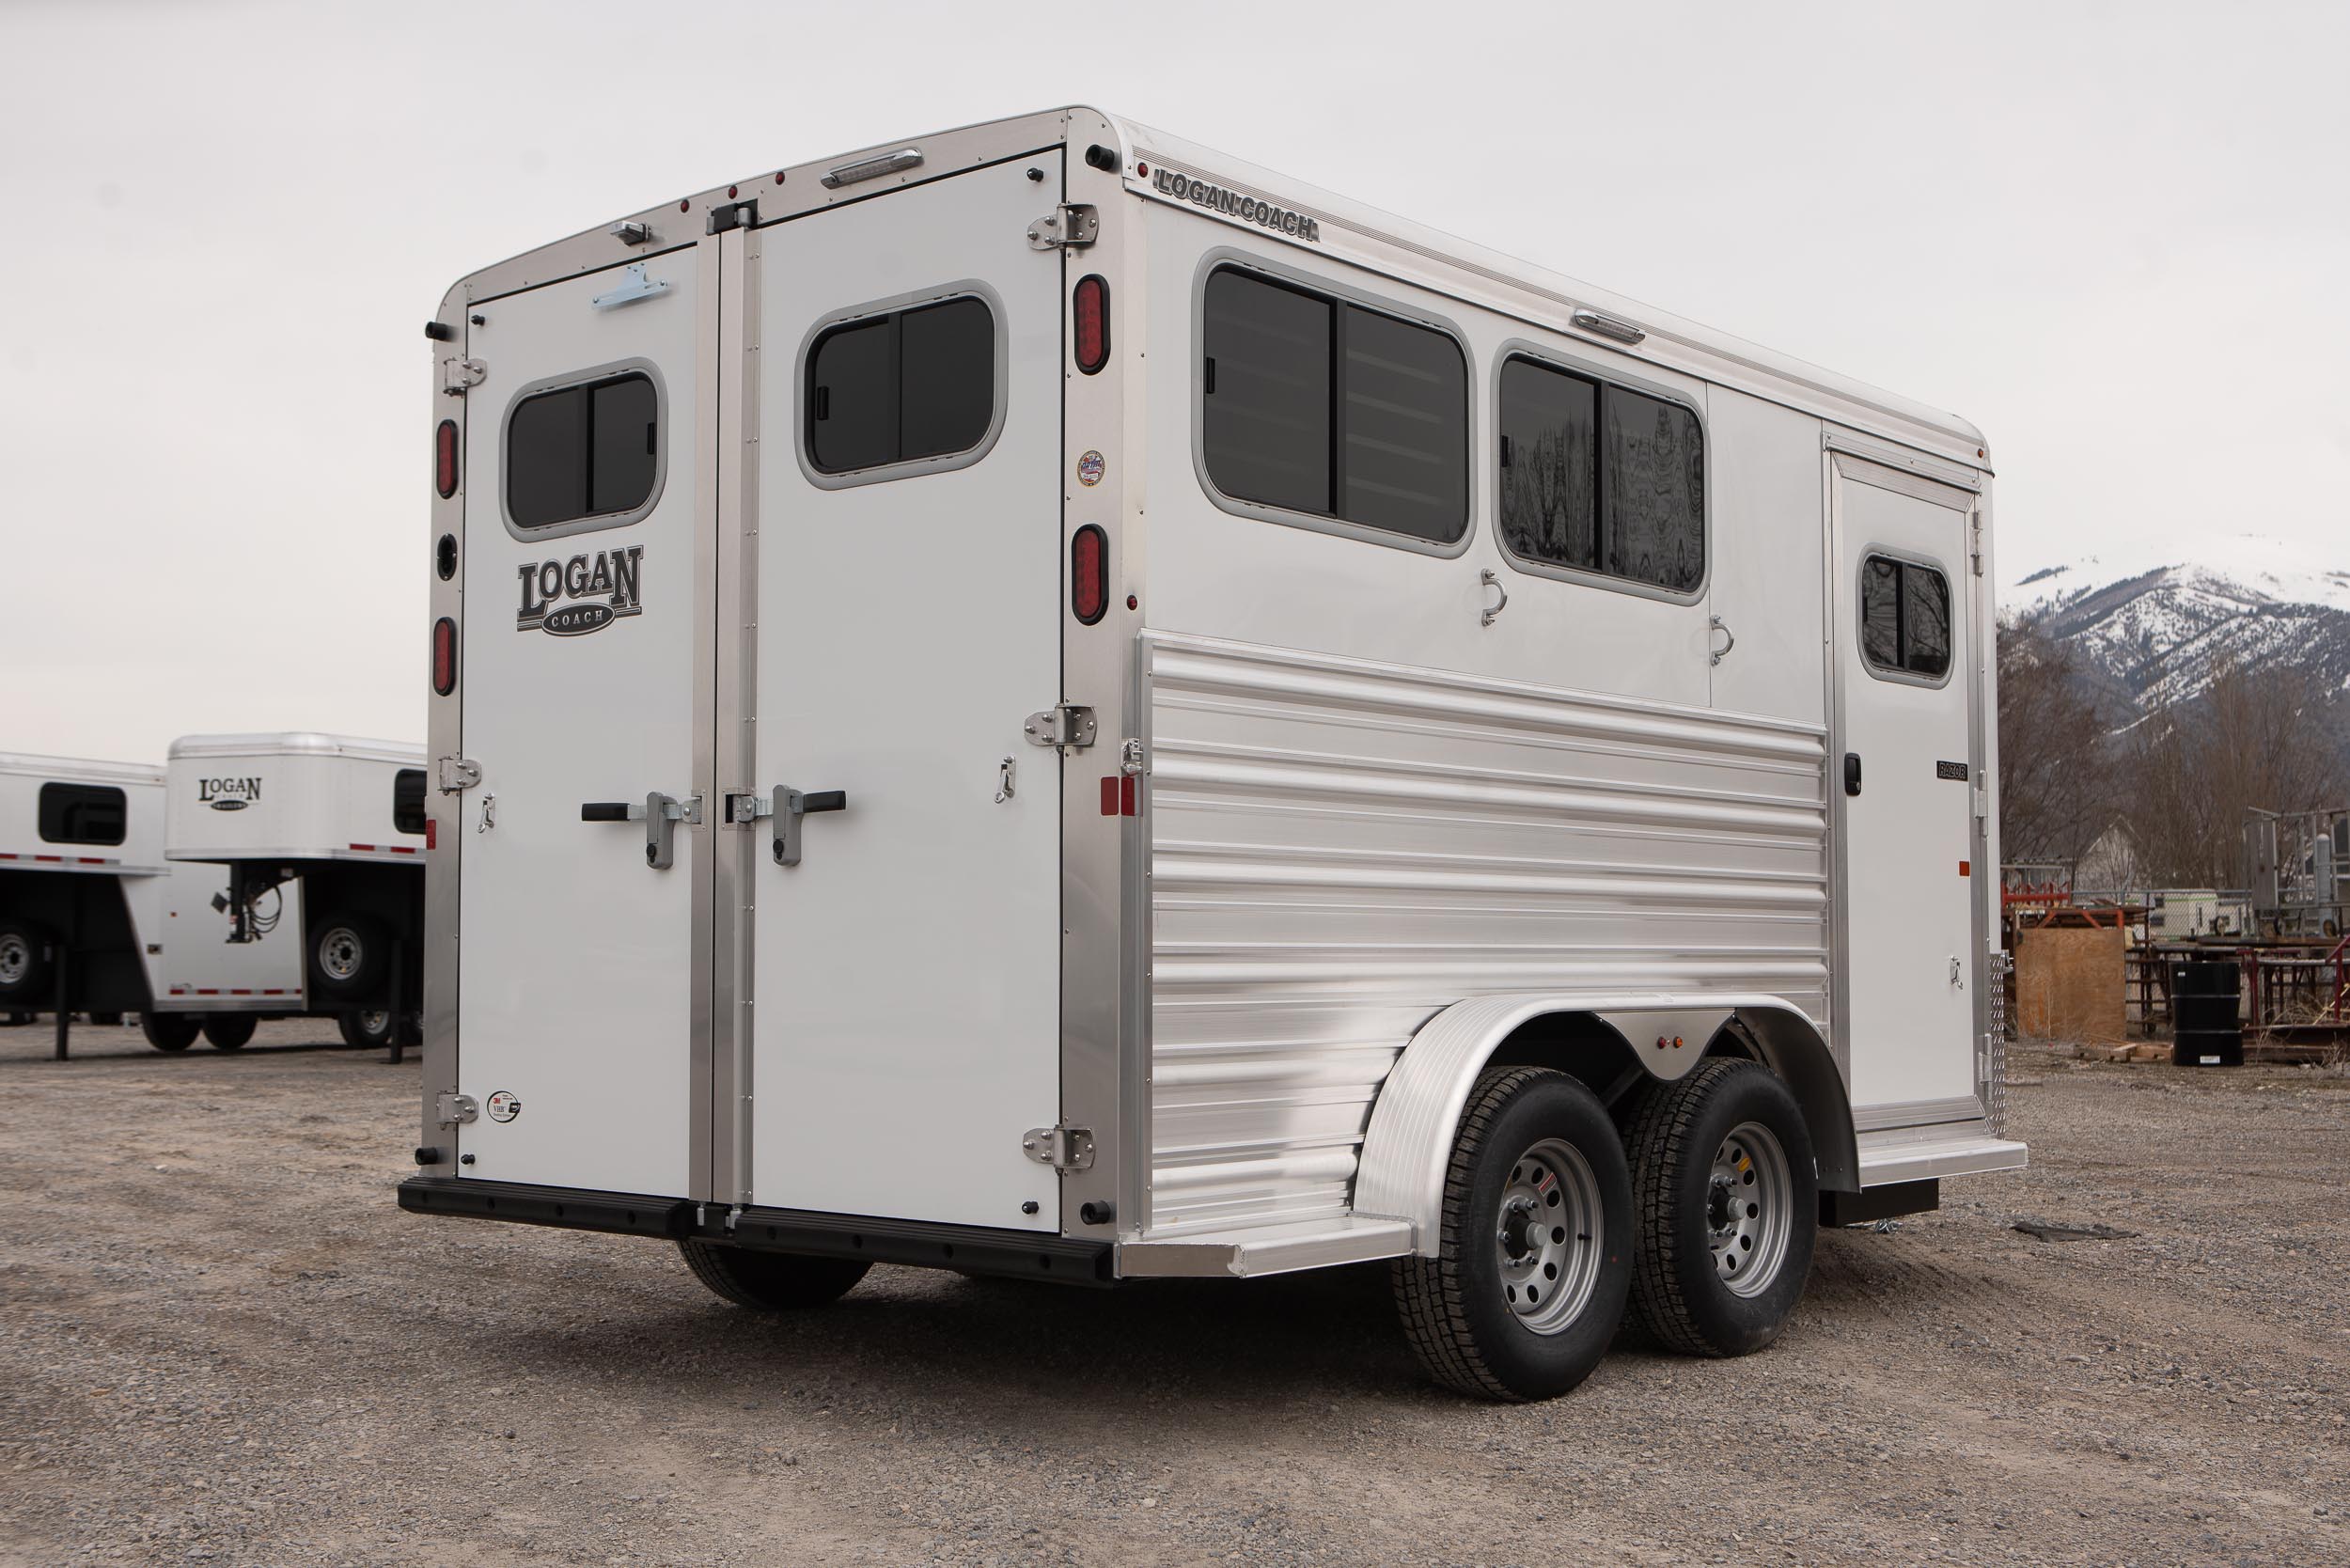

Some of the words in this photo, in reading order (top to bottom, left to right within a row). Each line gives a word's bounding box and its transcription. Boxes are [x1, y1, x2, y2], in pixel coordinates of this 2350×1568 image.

[1156, 168, 1237, 216] LOGAN
[1238, 196, 1315, 242] COACH
[517, 545, 644, 622] LOGAN
[551, 609, 603, 628] COACH
[1938, 761, 1966, 779] RAZOR
[198, 777, 262, 801] LOGAN
